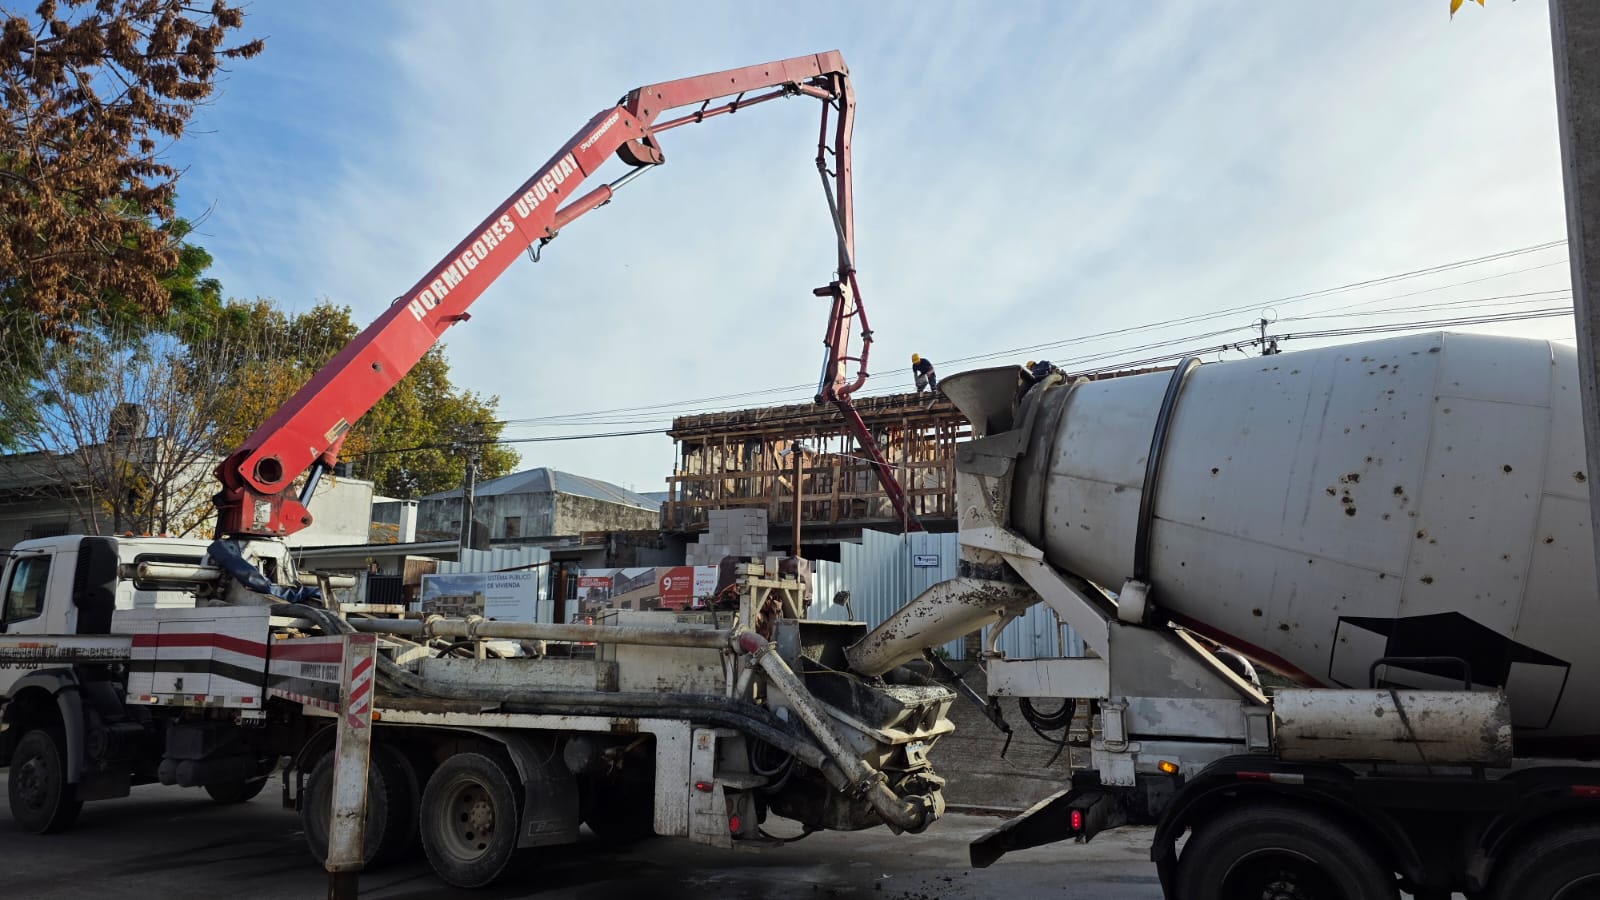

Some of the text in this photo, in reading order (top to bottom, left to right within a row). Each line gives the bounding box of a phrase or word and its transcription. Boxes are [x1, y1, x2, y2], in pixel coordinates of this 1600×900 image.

[408, 153, 579, 321] HORMIGONES URUGUAY
[663, 577, 672, 591] 9
